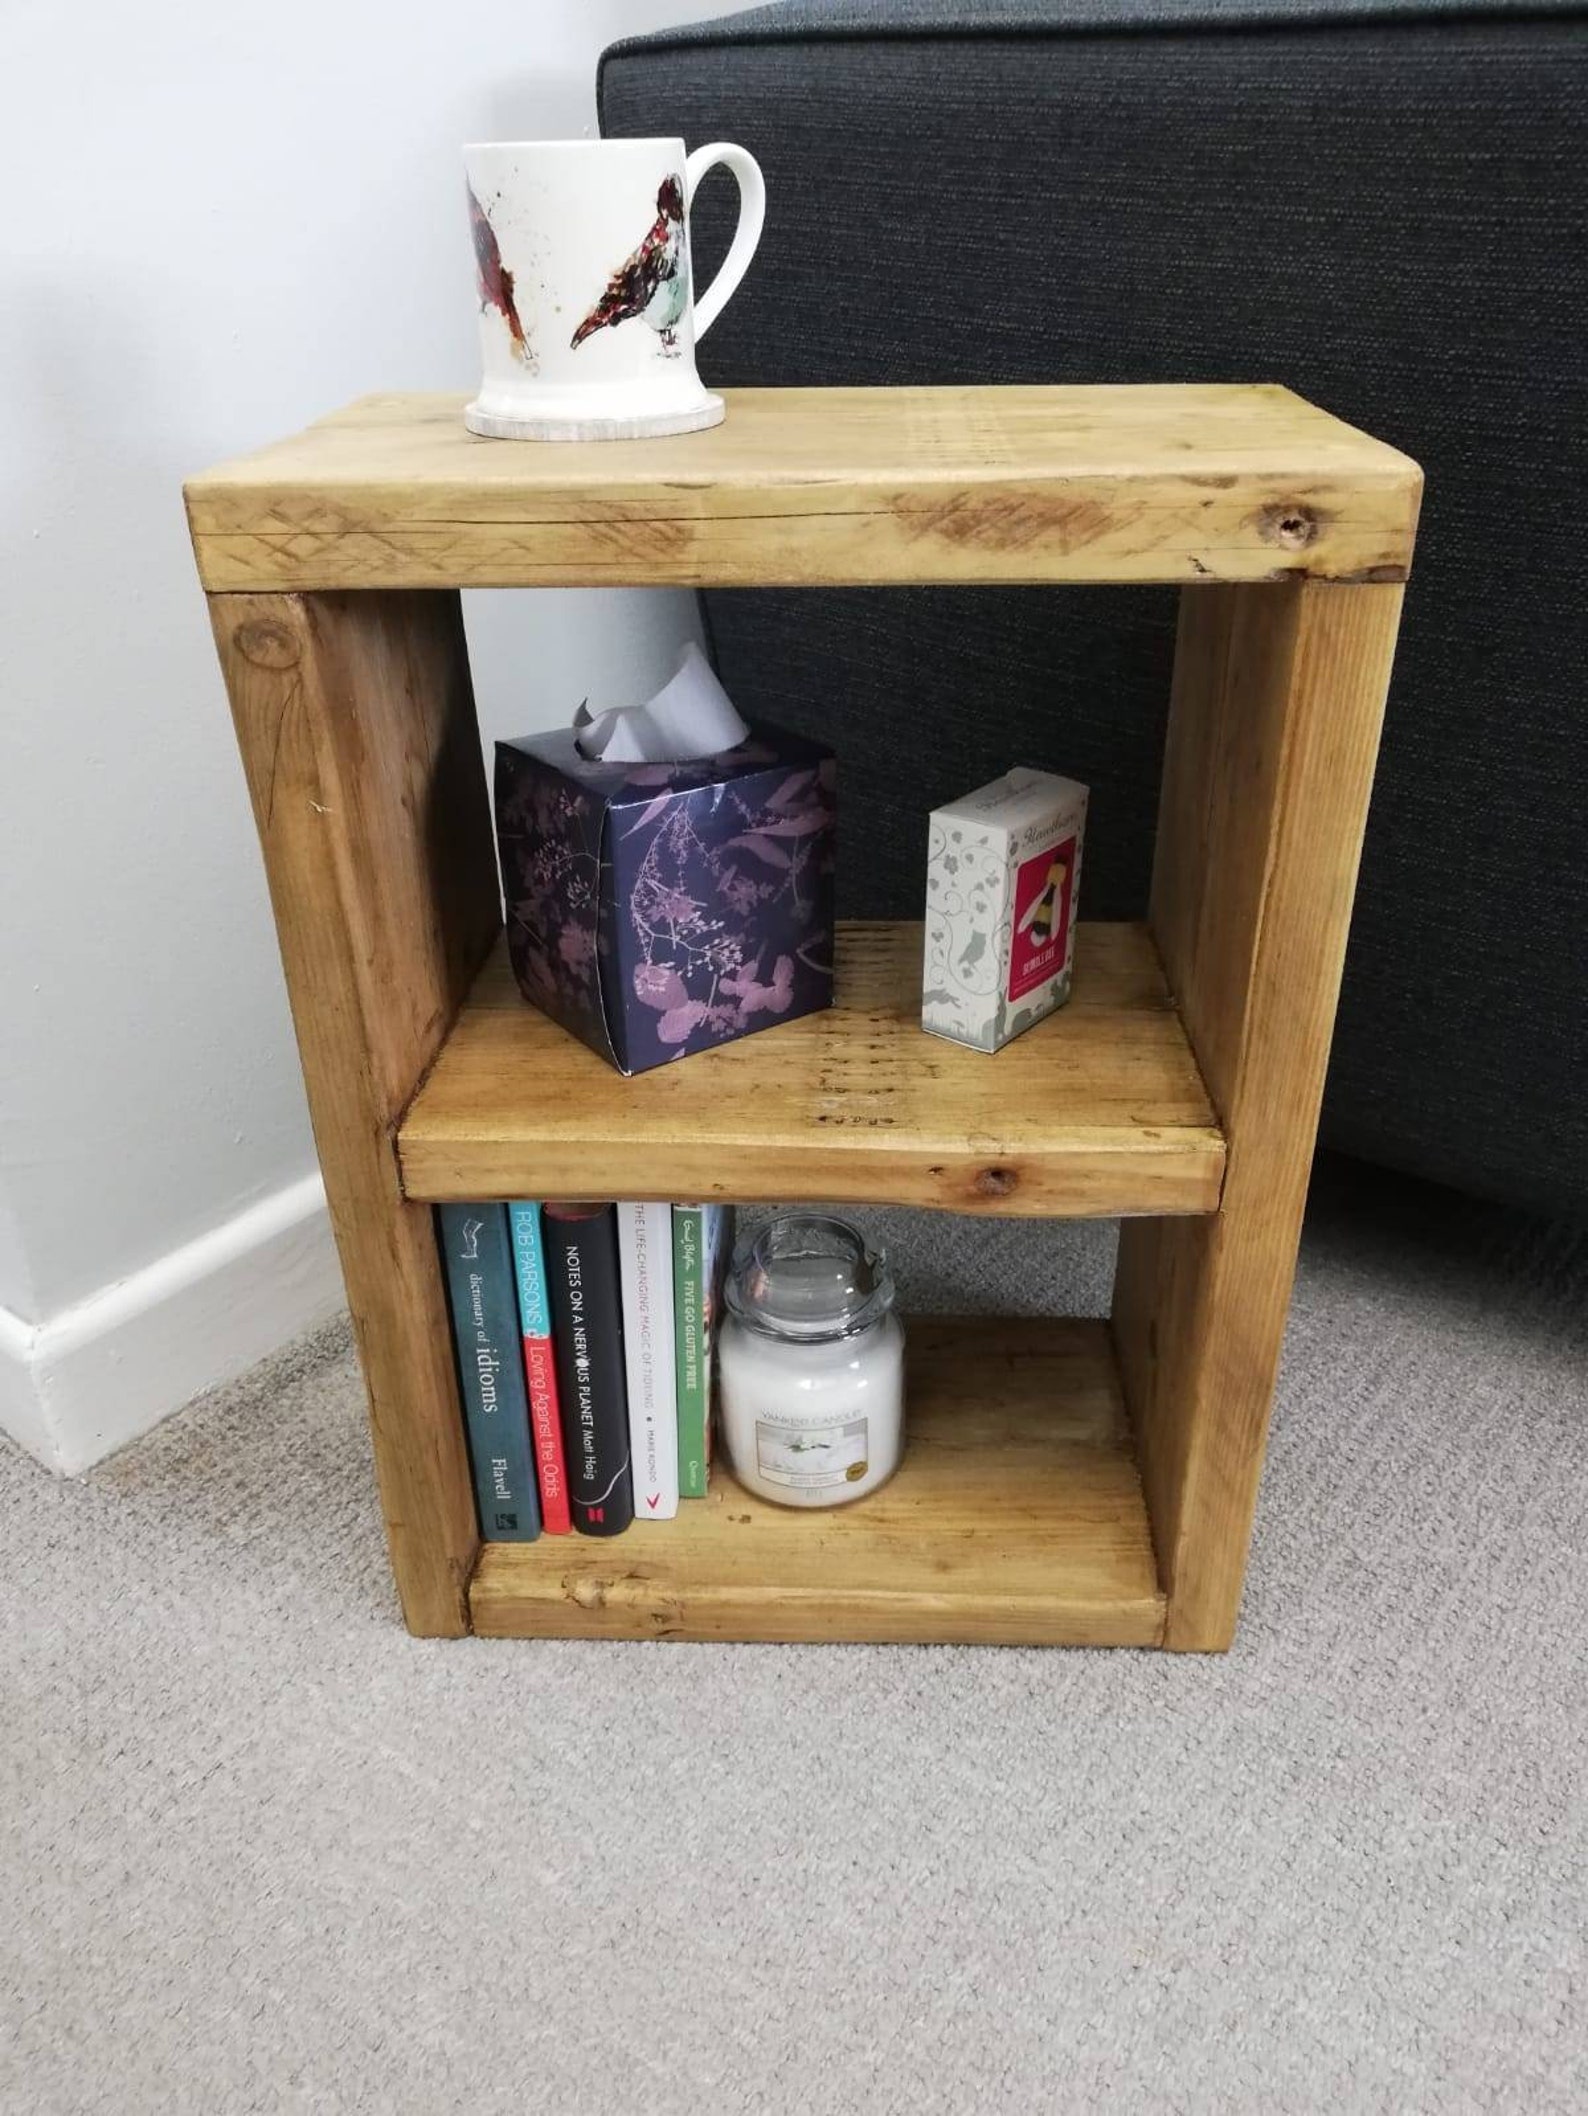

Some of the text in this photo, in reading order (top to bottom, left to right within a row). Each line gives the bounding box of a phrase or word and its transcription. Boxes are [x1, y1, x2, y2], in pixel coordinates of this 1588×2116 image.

[516, 1211, 543, 1324] ROB PARSONS
[635, 1204, 645, 1225] THE
[641, 1316, 653, 1350] MAGIC
[469, 1273, 500, 1413] dictionary of idioms
[566, 1246, 594, 1427] NOTES ON A NERVOUS PLANET
[684, 1281, 698, 1390] FIVE GO GLUTEN FREE
[491, 1458, 512, 1500] Flavell
[530, 1346, 560, 1498] Loving Against the Odds
[582, 1429, 597, 1481] Matt Haig
